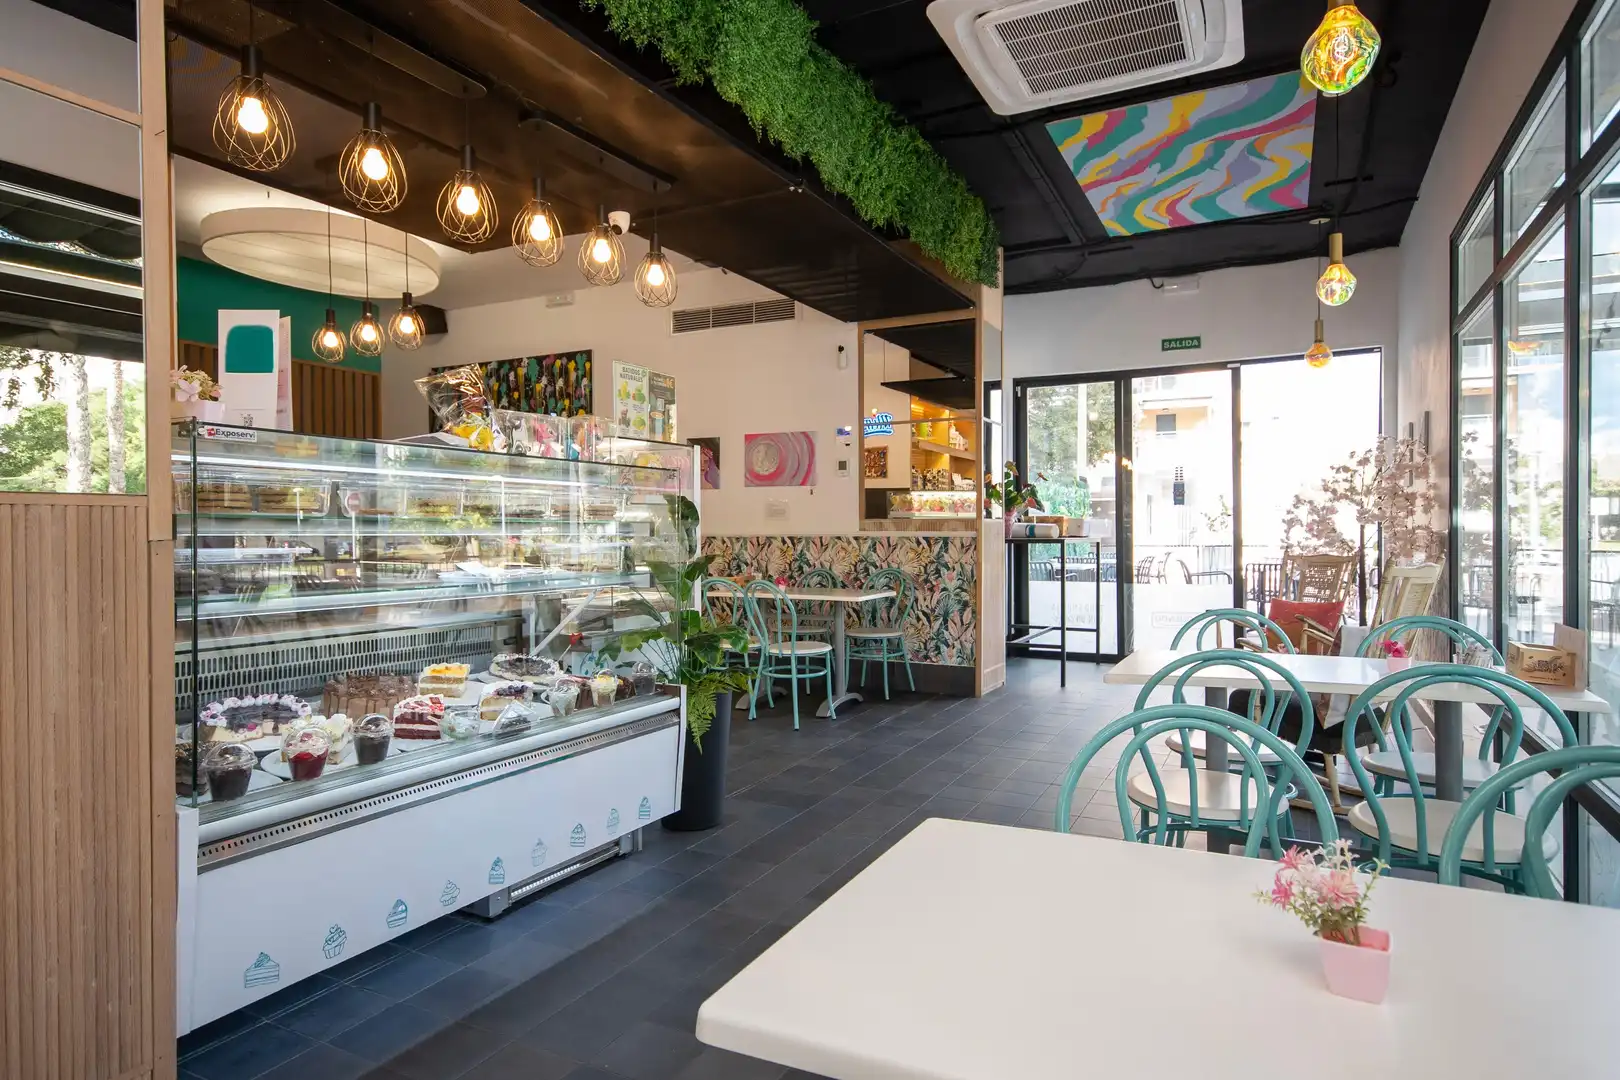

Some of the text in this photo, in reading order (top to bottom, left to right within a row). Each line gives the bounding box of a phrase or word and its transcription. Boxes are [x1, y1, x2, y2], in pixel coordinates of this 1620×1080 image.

[1163, 339, 1199, 348] SALIDA
[622, 366, 641, 376] BATIDOS
[620, 373, 643, 382] NATURALES
[215, 428, 255, 438] Exposervi
